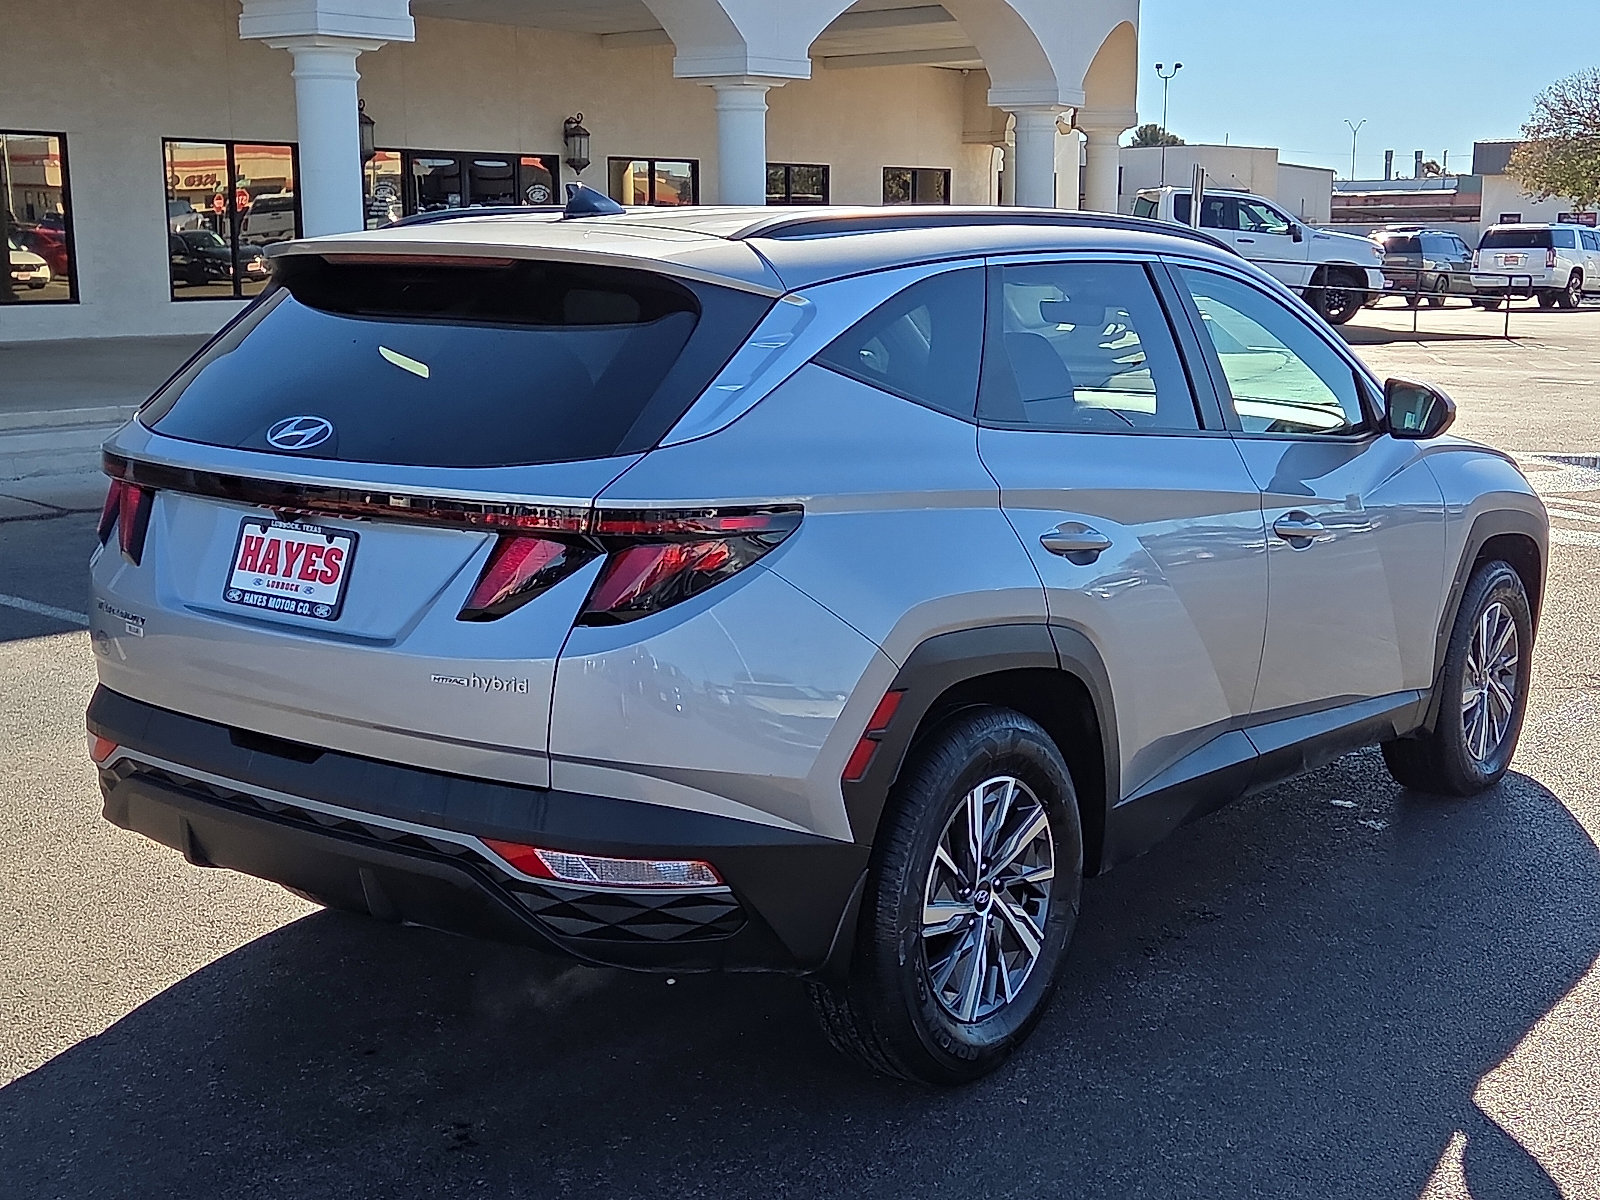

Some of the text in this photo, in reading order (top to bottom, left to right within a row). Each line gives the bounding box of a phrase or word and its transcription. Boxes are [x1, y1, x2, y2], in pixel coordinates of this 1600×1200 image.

[302, 524, 322, 533] TEXAS
[238, 535, 344, 585] HAYES
[266, 580, 301, 592] LUBBOCK
[243, 592, 267, 606] HAYES
[269, 596, 296, 611] MOTOR
[297, 602, 311, 615] CO.
[472, 672, 529, 693] hybrid
